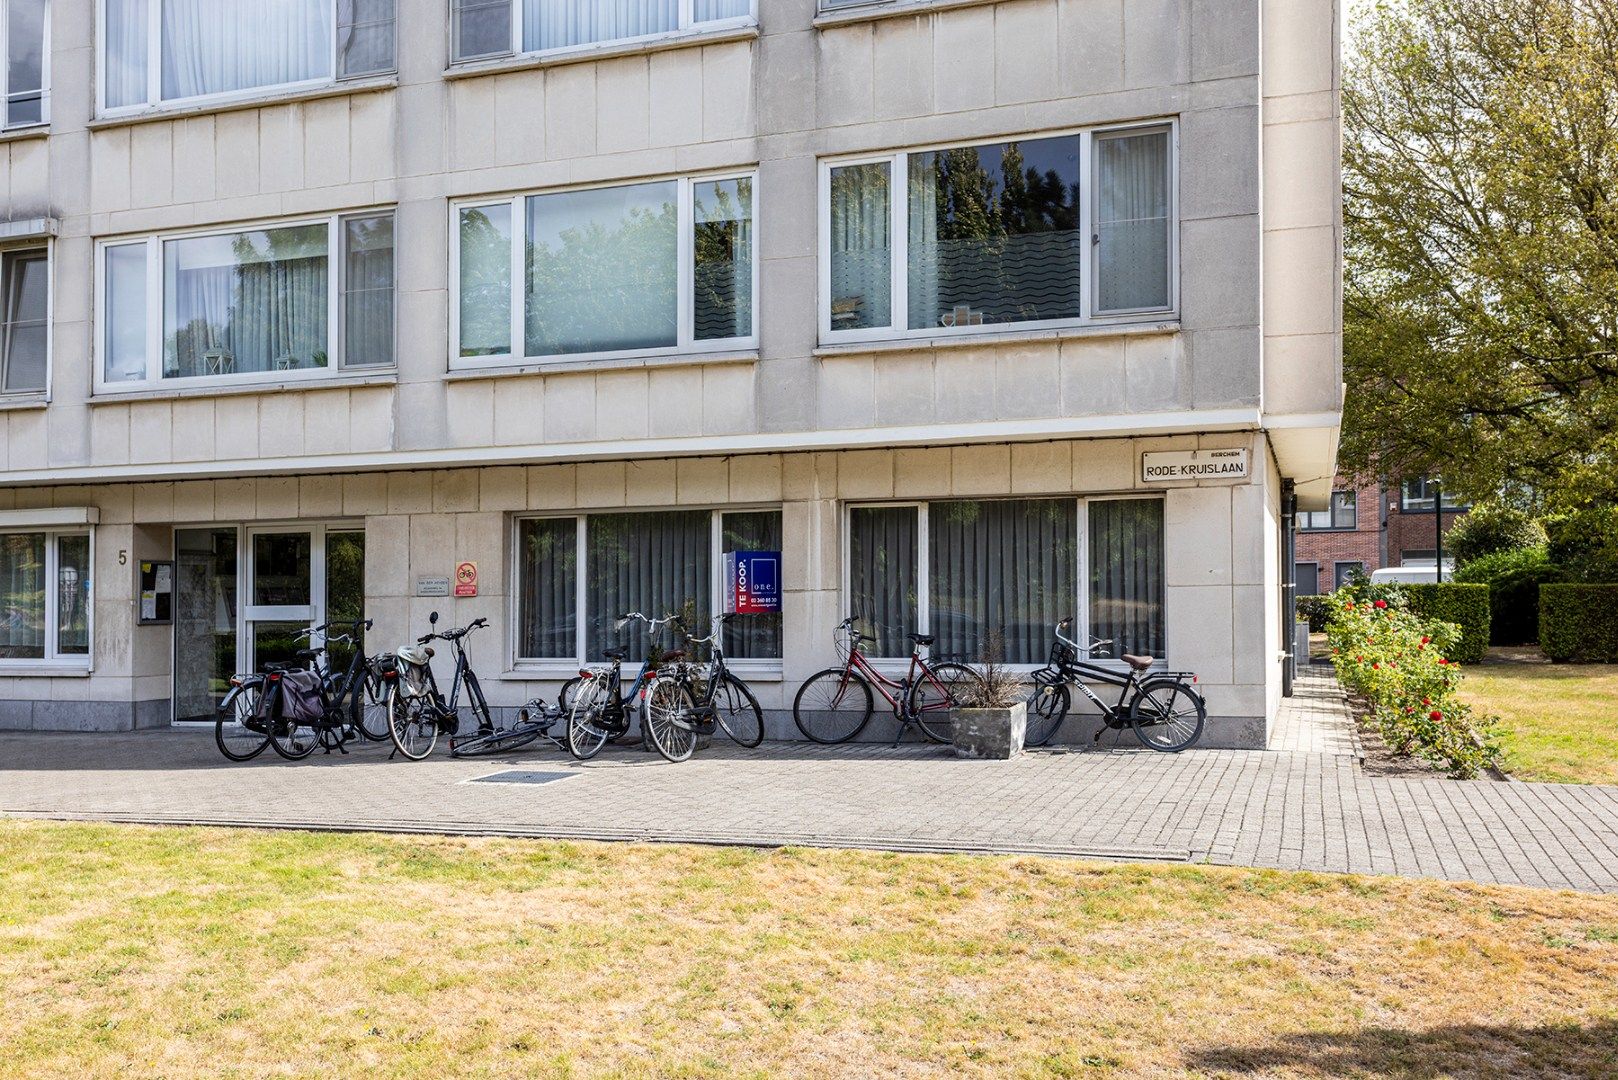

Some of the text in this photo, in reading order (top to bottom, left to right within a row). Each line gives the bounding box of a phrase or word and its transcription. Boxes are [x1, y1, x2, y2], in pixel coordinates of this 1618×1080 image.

[1146, 462, 1244, 476] RODE-KRUISLAAN
[118, 550, 127, 565] 5
[738, 559, 747, 607] TE KOOP.
